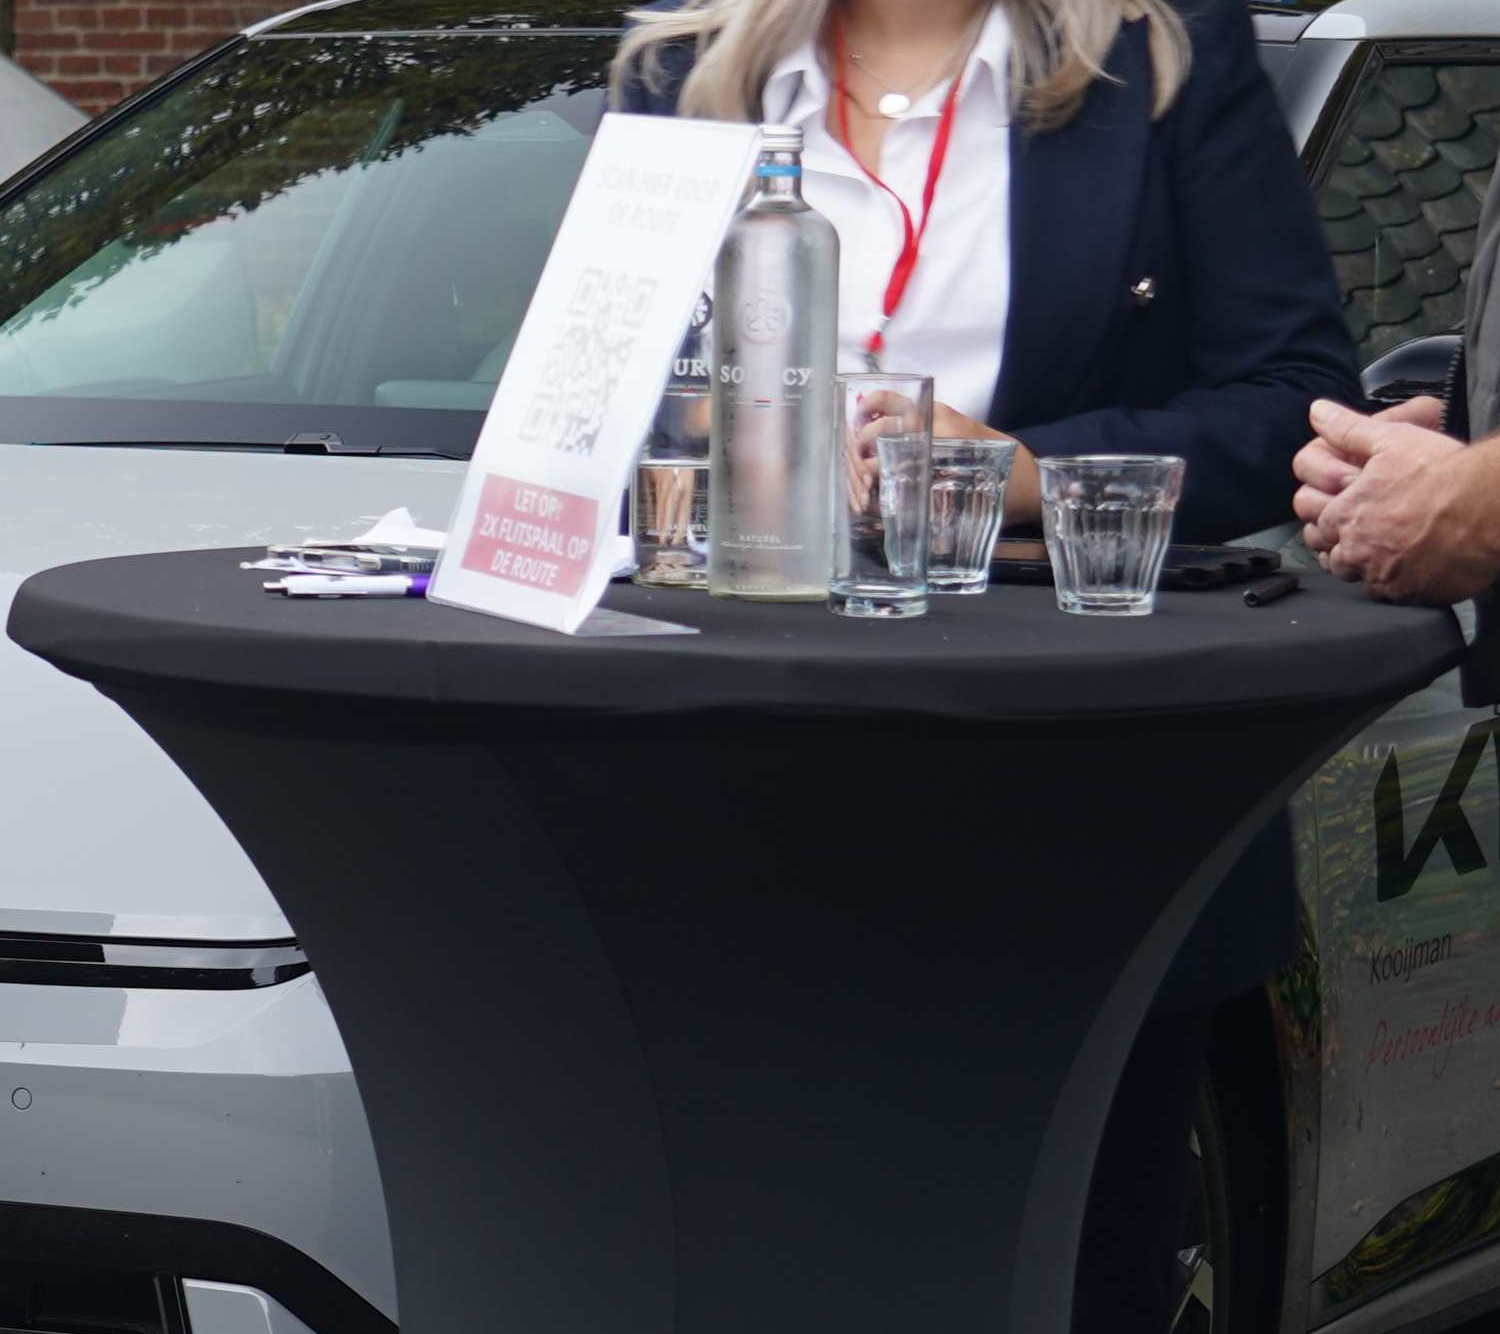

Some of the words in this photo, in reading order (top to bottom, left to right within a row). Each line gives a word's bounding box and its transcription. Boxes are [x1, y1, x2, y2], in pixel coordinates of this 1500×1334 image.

[720, 365, 813, 386] SOCY
[514, 487, 538, 513] LET
[479, 513, 500, 538] 2X
[498, 518, 564, 556] FLITSPAAL
[567, 536, 589, 561] OP
[490, 549, 514, 574] DE
[510, 555, 560, 587] ROUTE
[1370, 933, 1451, 985] Kooijman
[1366, 996, 1479, 1080] Persoonlijke
